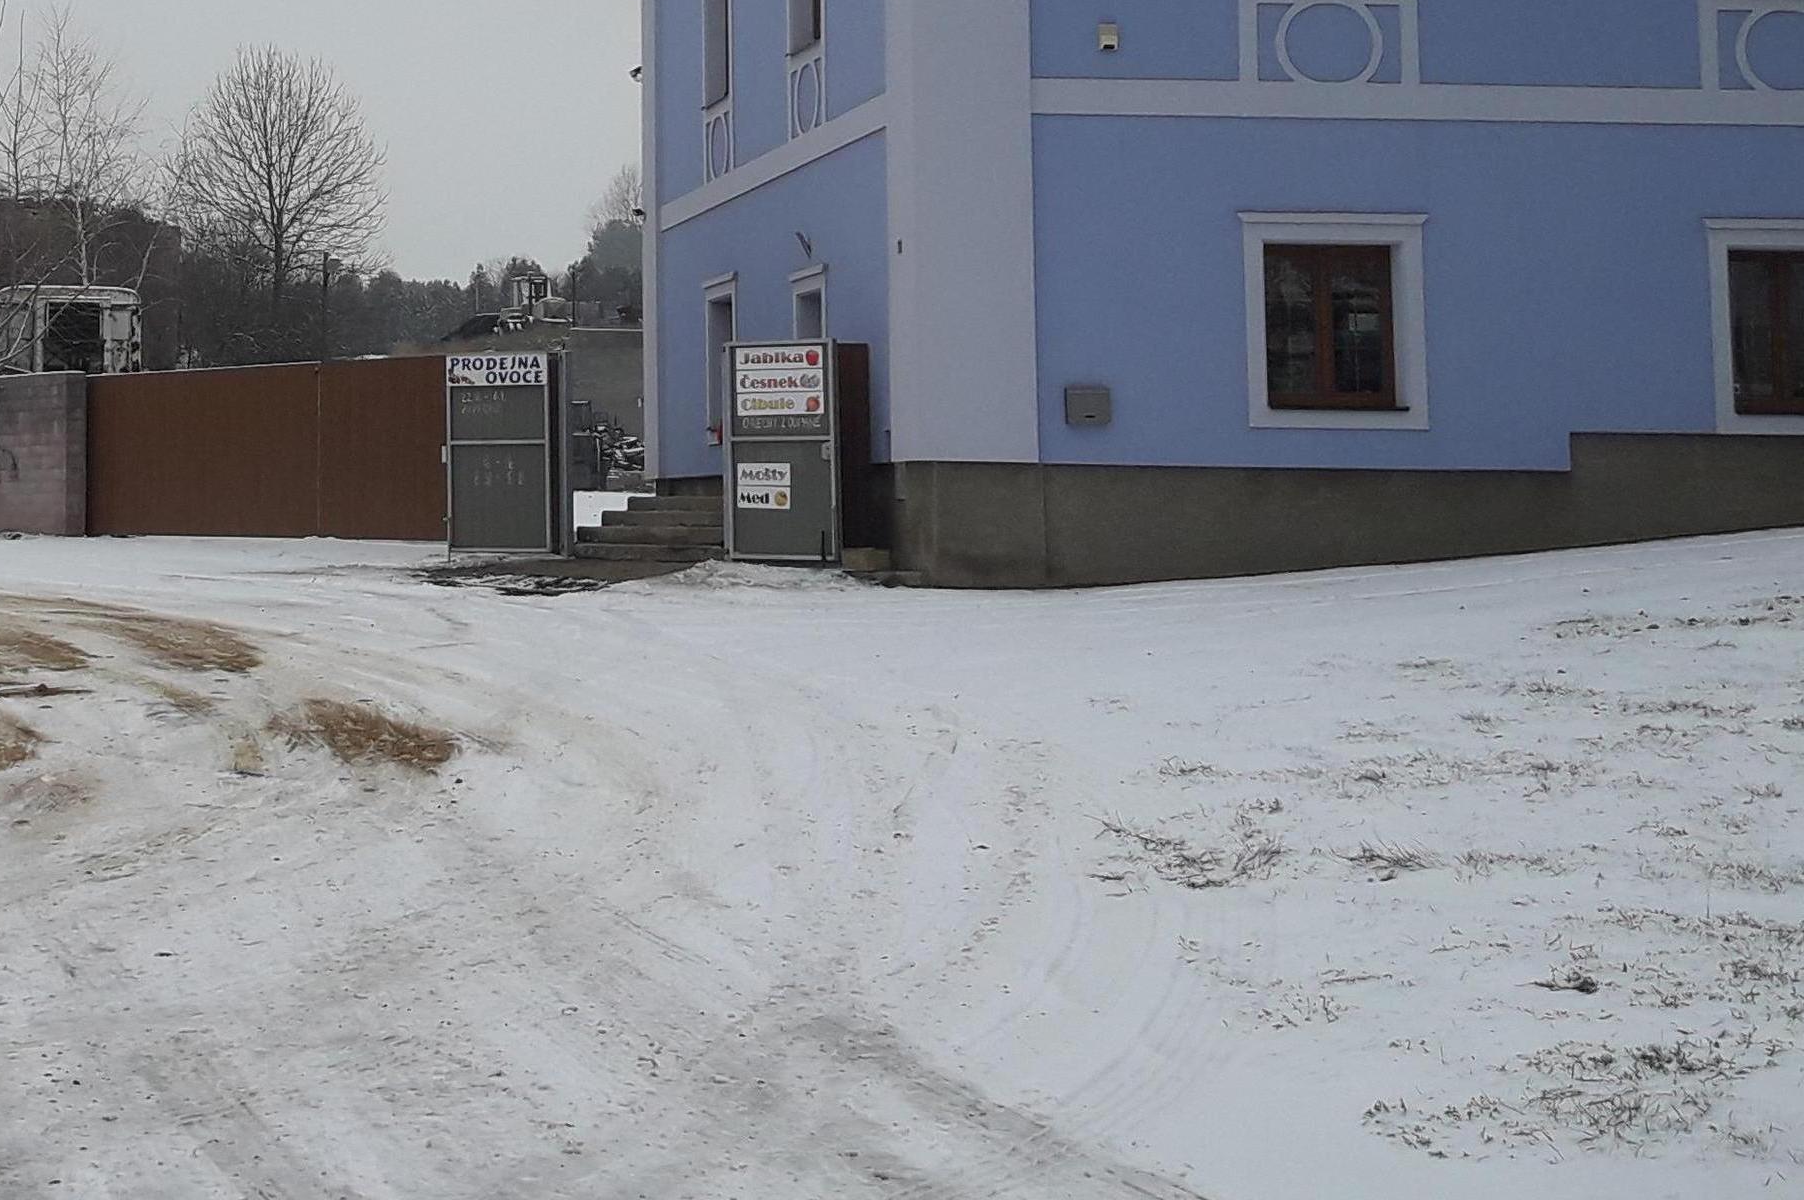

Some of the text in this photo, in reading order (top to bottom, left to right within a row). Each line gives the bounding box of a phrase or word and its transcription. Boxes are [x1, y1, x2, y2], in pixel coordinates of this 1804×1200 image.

[450, 357, 540, 371] PRODEJNA
[739, 352, 804, 365] Jablka
[485, 370, 543, 384] OVOCE
[739, 374, 799, 389] Česnek
[739, 468, 788, 482] Mošty
[738, 492, 770, 505] Med
